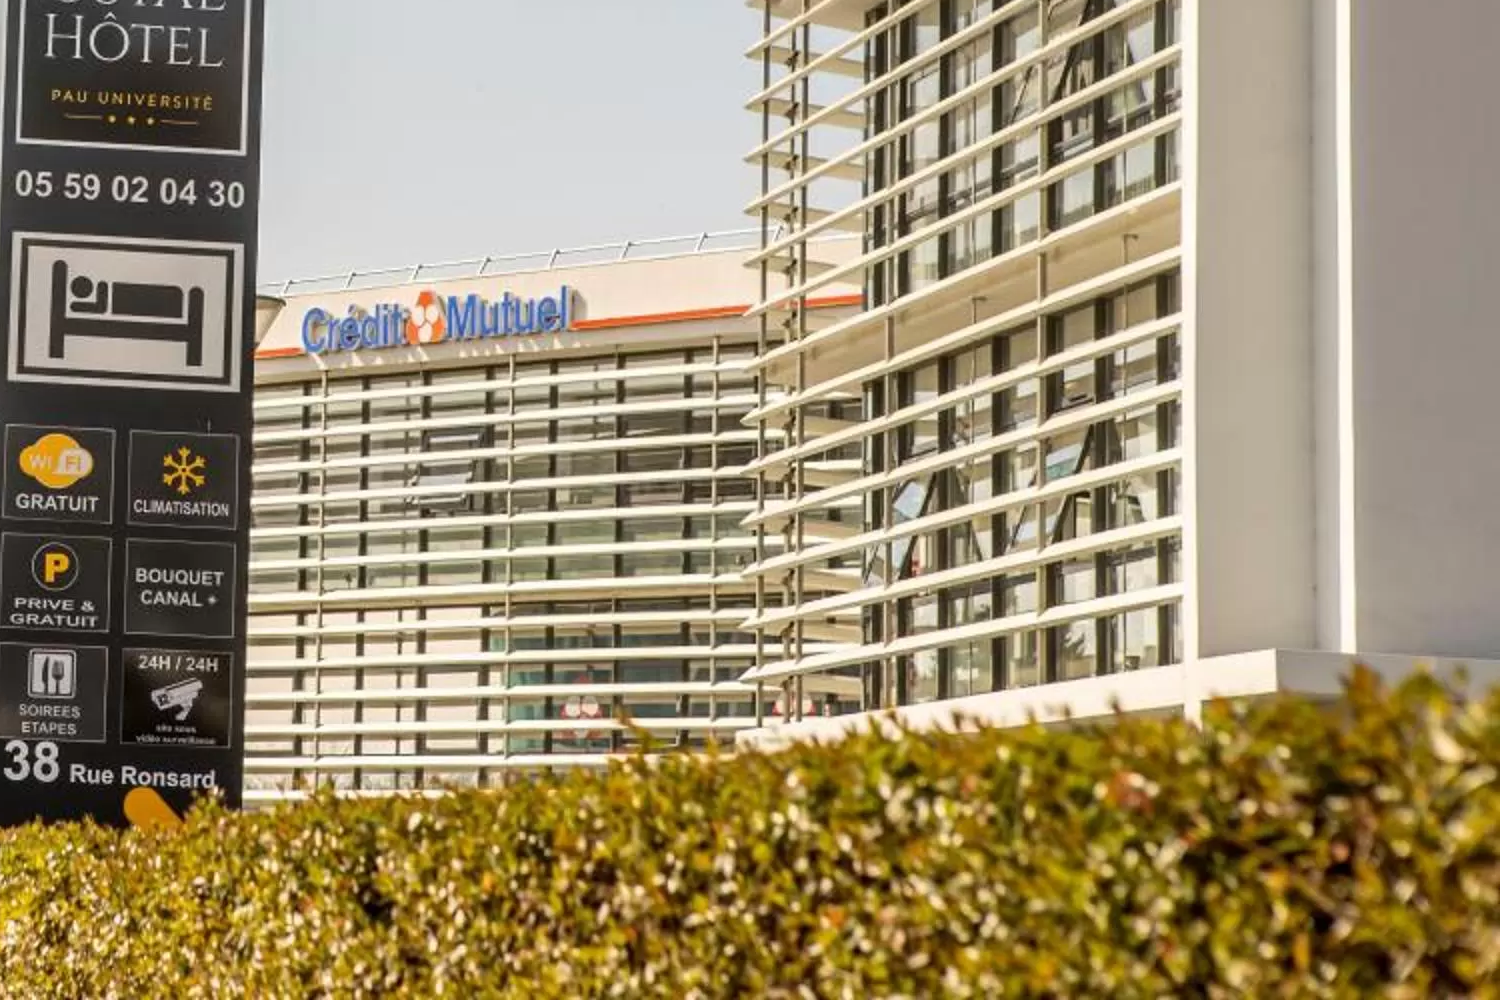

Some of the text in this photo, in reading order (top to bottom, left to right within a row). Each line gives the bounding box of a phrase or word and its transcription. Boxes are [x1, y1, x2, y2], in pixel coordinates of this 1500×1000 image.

[44, 11, 225, 67] HÔTEL
[51, 89, 213, 111] PAU UNIVERSITÉ
[15, 170, 245, 208] 05 59 02 04 30
[301, 284, 573, 353] Crédit Mutuel
[15, 492, 100, 513] GRATUIT
[133, 499, 230, 517] CLIMATISATION
[43, 552, 70, 583] P
[135, 567, 225, 586] BOUQUET
[14, 597, 96, 613] PRIVE &
[141, 589, 204, 607] CANAL
[9, 612, 99, 628] GRATUIT
[138, 654, 171, 671] 24H
[185, 657, 219, 673] 24H
[19, 703, 81, 719] SOIREES
[21, 720, 77, 736] ETAPES
[3, 739, 216, 789] 38 Rue Ronsard
